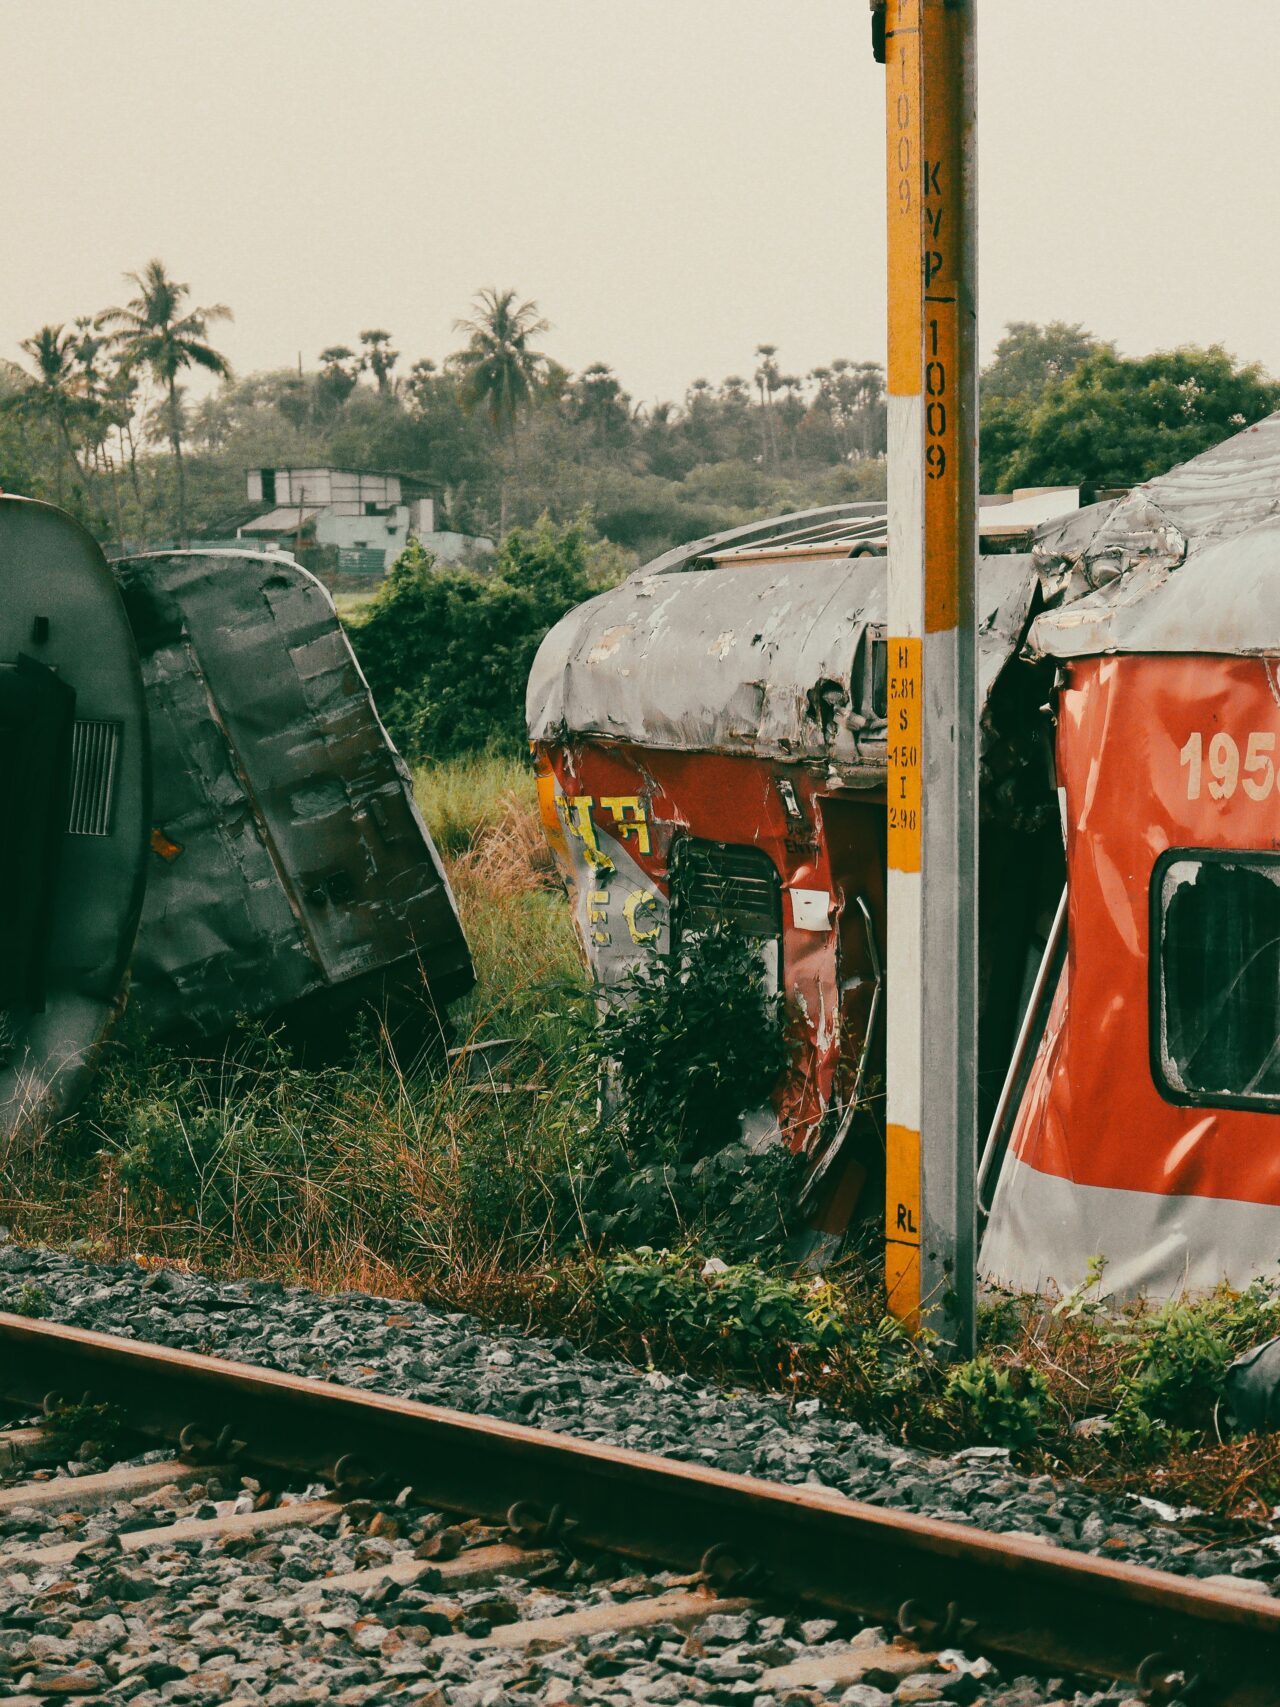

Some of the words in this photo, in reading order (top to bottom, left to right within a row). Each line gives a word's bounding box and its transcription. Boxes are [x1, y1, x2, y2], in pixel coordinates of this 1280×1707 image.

[926, 319, 946, 479] 1009
[899, 646, 908, 668] H
[899, 708, 908, 731] S
[897, 1203, 917, 1233] RL
